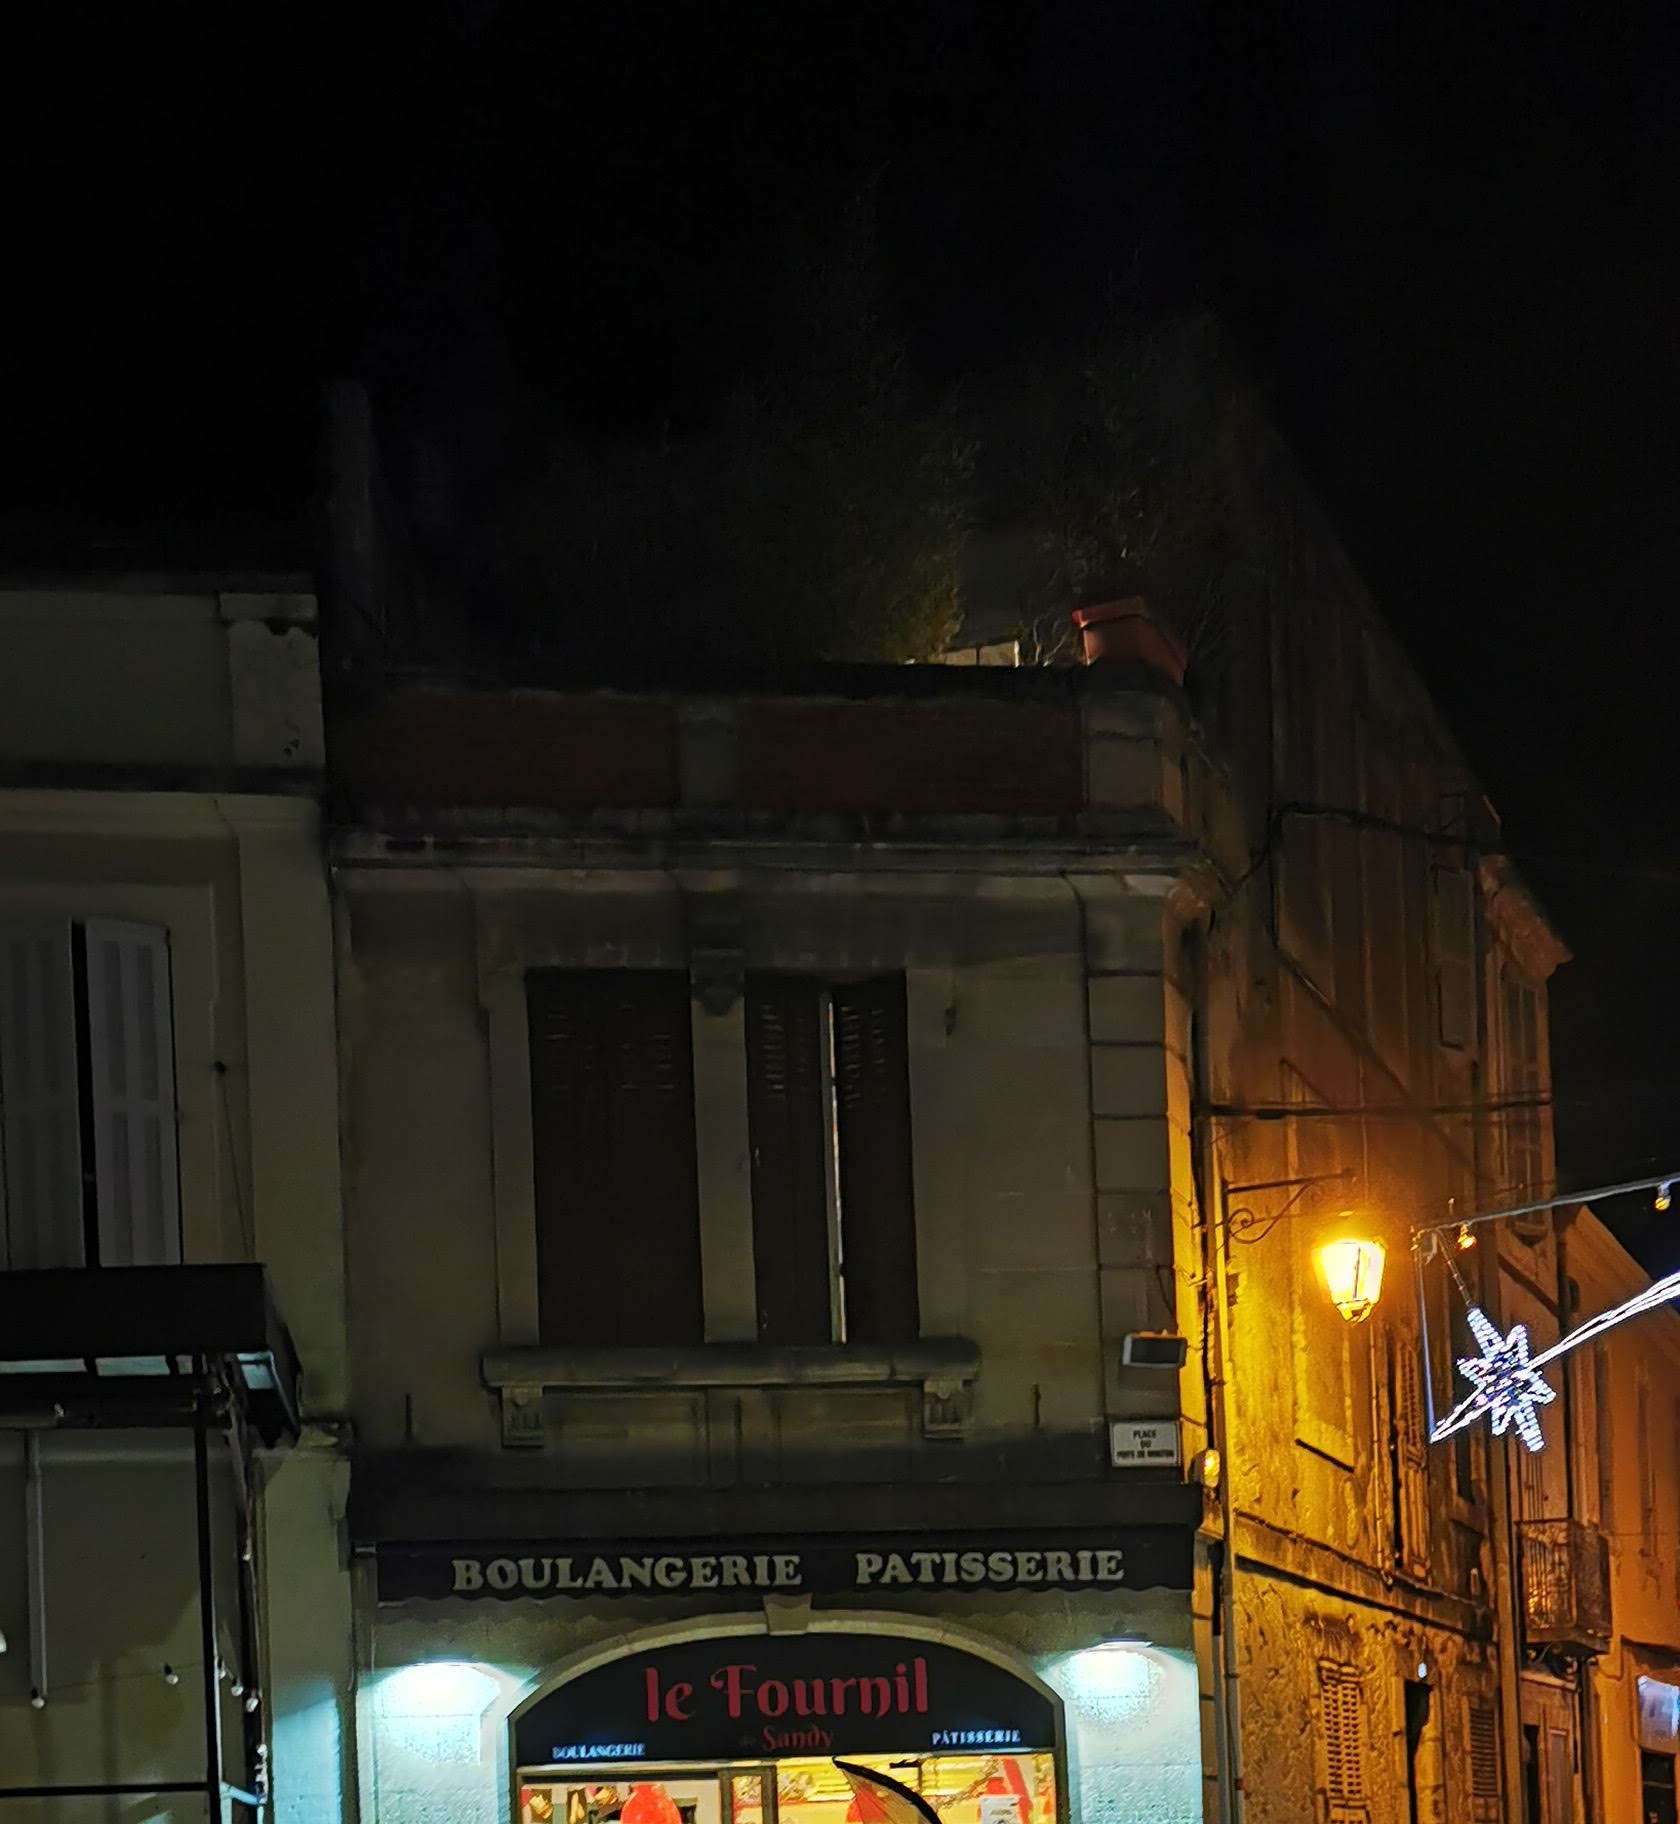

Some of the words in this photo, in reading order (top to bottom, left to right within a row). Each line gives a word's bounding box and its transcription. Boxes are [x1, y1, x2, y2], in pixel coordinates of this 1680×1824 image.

[1132, 1429, 1157, 1441] PLACE
[454, 1555, 802, 1591] BOULANGERIE
[855, 1551, 1124, 1585] PATISSERIE
[646, 1667, 695, 1722] le
[710, 1657, 928, 1719] Fournil
[762, 1725, 833, 1750] Sandy
[932, 1730, 1020, 1745] PÂTISSERIE
[552, 1743, 646, 1759] BOULANGERIE
